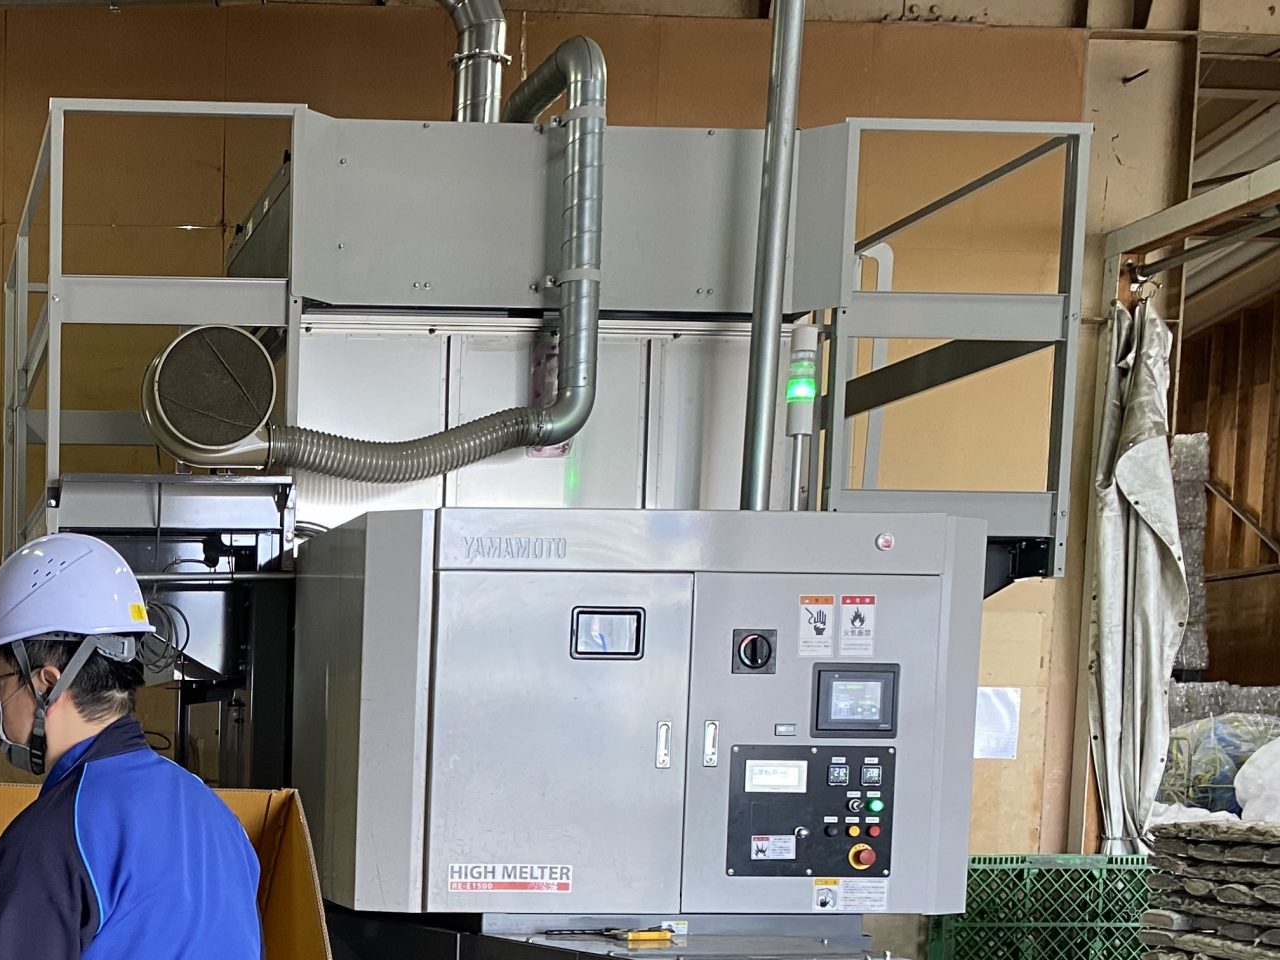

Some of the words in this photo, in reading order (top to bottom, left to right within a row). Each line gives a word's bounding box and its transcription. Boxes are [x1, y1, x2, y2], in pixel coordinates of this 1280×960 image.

[463, 536, 567, 559] YAMAMOTO
[449, 864, 496, 880] HIGH
[501, 865, 571, 881] MELTER
[451, 882, 494, 890] RE-E1500
